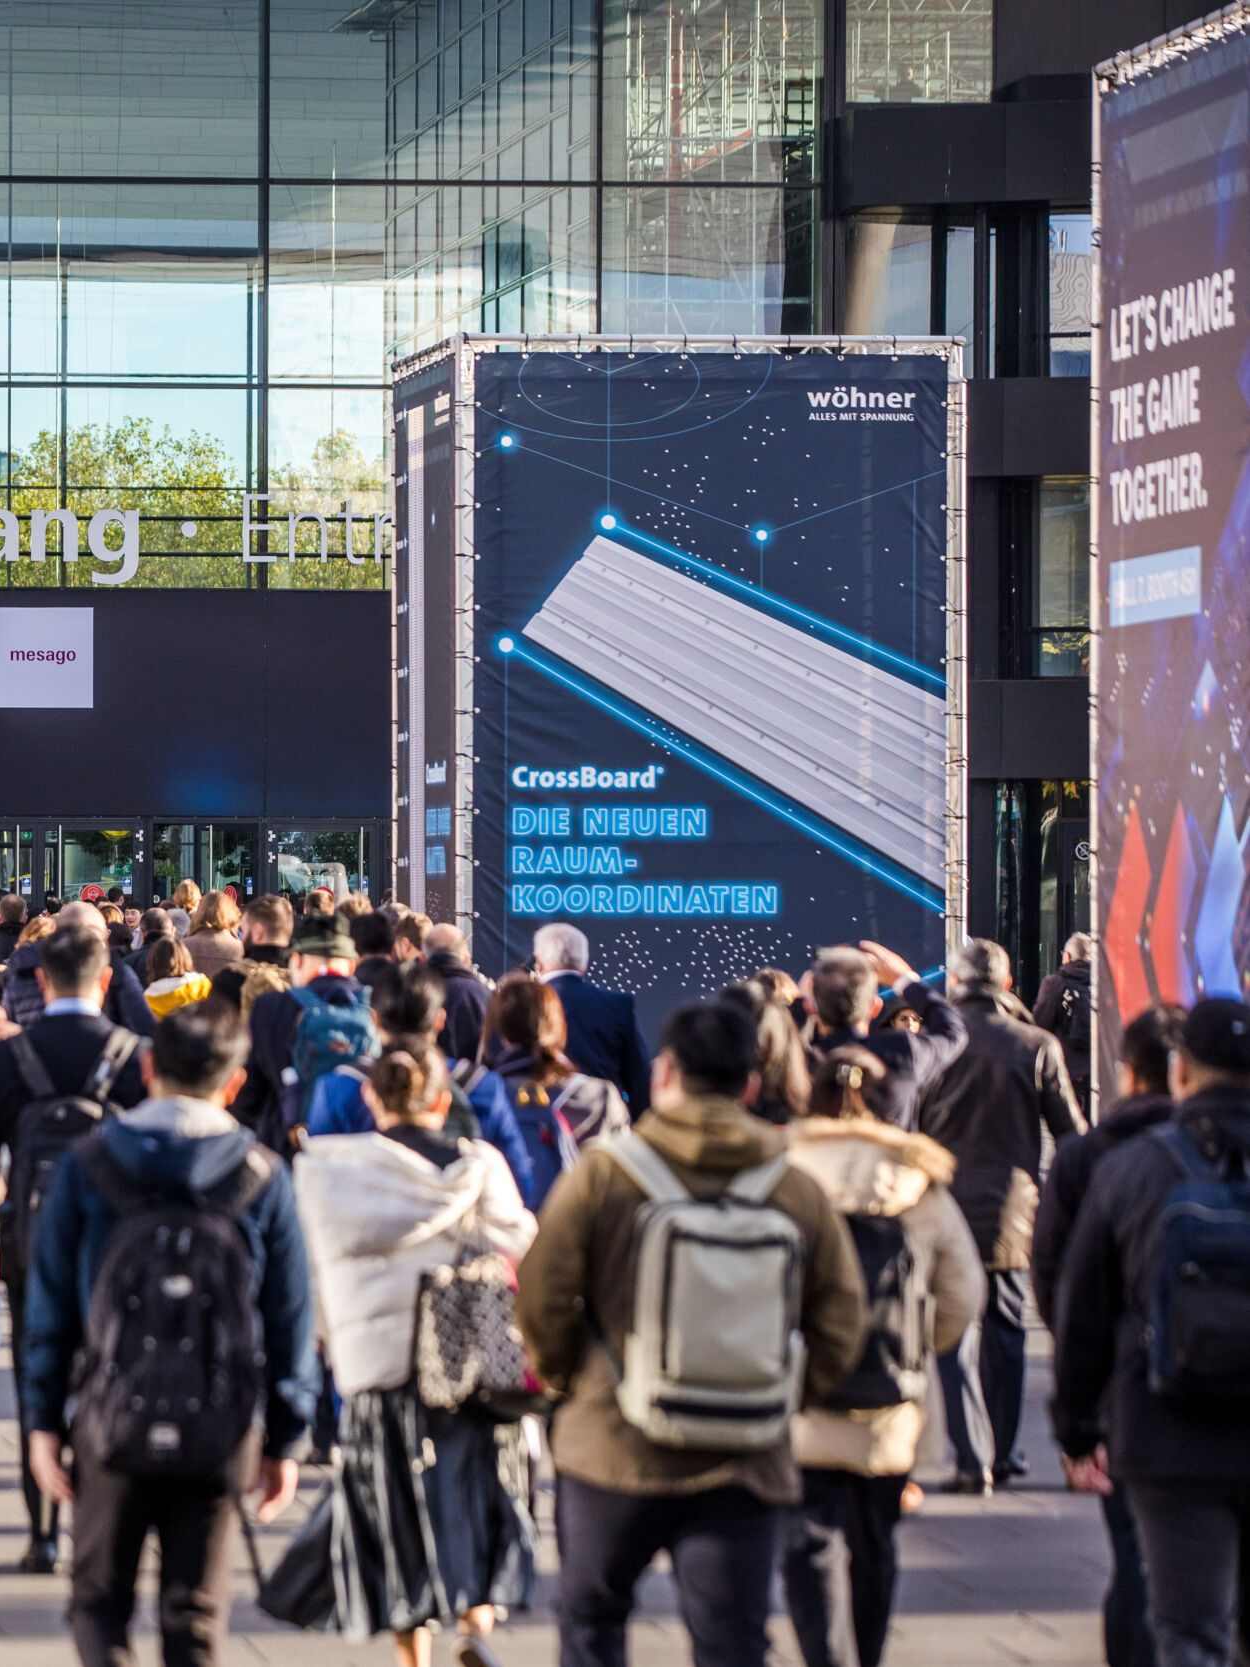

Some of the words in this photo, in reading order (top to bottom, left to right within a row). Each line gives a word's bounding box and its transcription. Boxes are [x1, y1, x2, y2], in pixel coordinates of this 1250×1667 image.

[1110, 295, 1158, 363] LET'S
[1159, 267, 1235, 348] CHANGE
[807, 387, 916, 408] wöhner
[1109, 381, 1145, 444] THE
[1146, 365, 1201, 436] GAME
[808, 413, 837, 421] ALLES
[839, 413, 858, 421] MIT
[860, 413, 915, 422] SPANNUNG
[1109, 451, 1209, 526] TOGETHER.
[10, 648, 77, 666] mesago
[512, 807, 570, 836] DIE
[583, 808, 707, 836] NEUEN
[512, 846, 638, 874] RAUM-
[512, 884, 778, 914] KOORDINATEN
